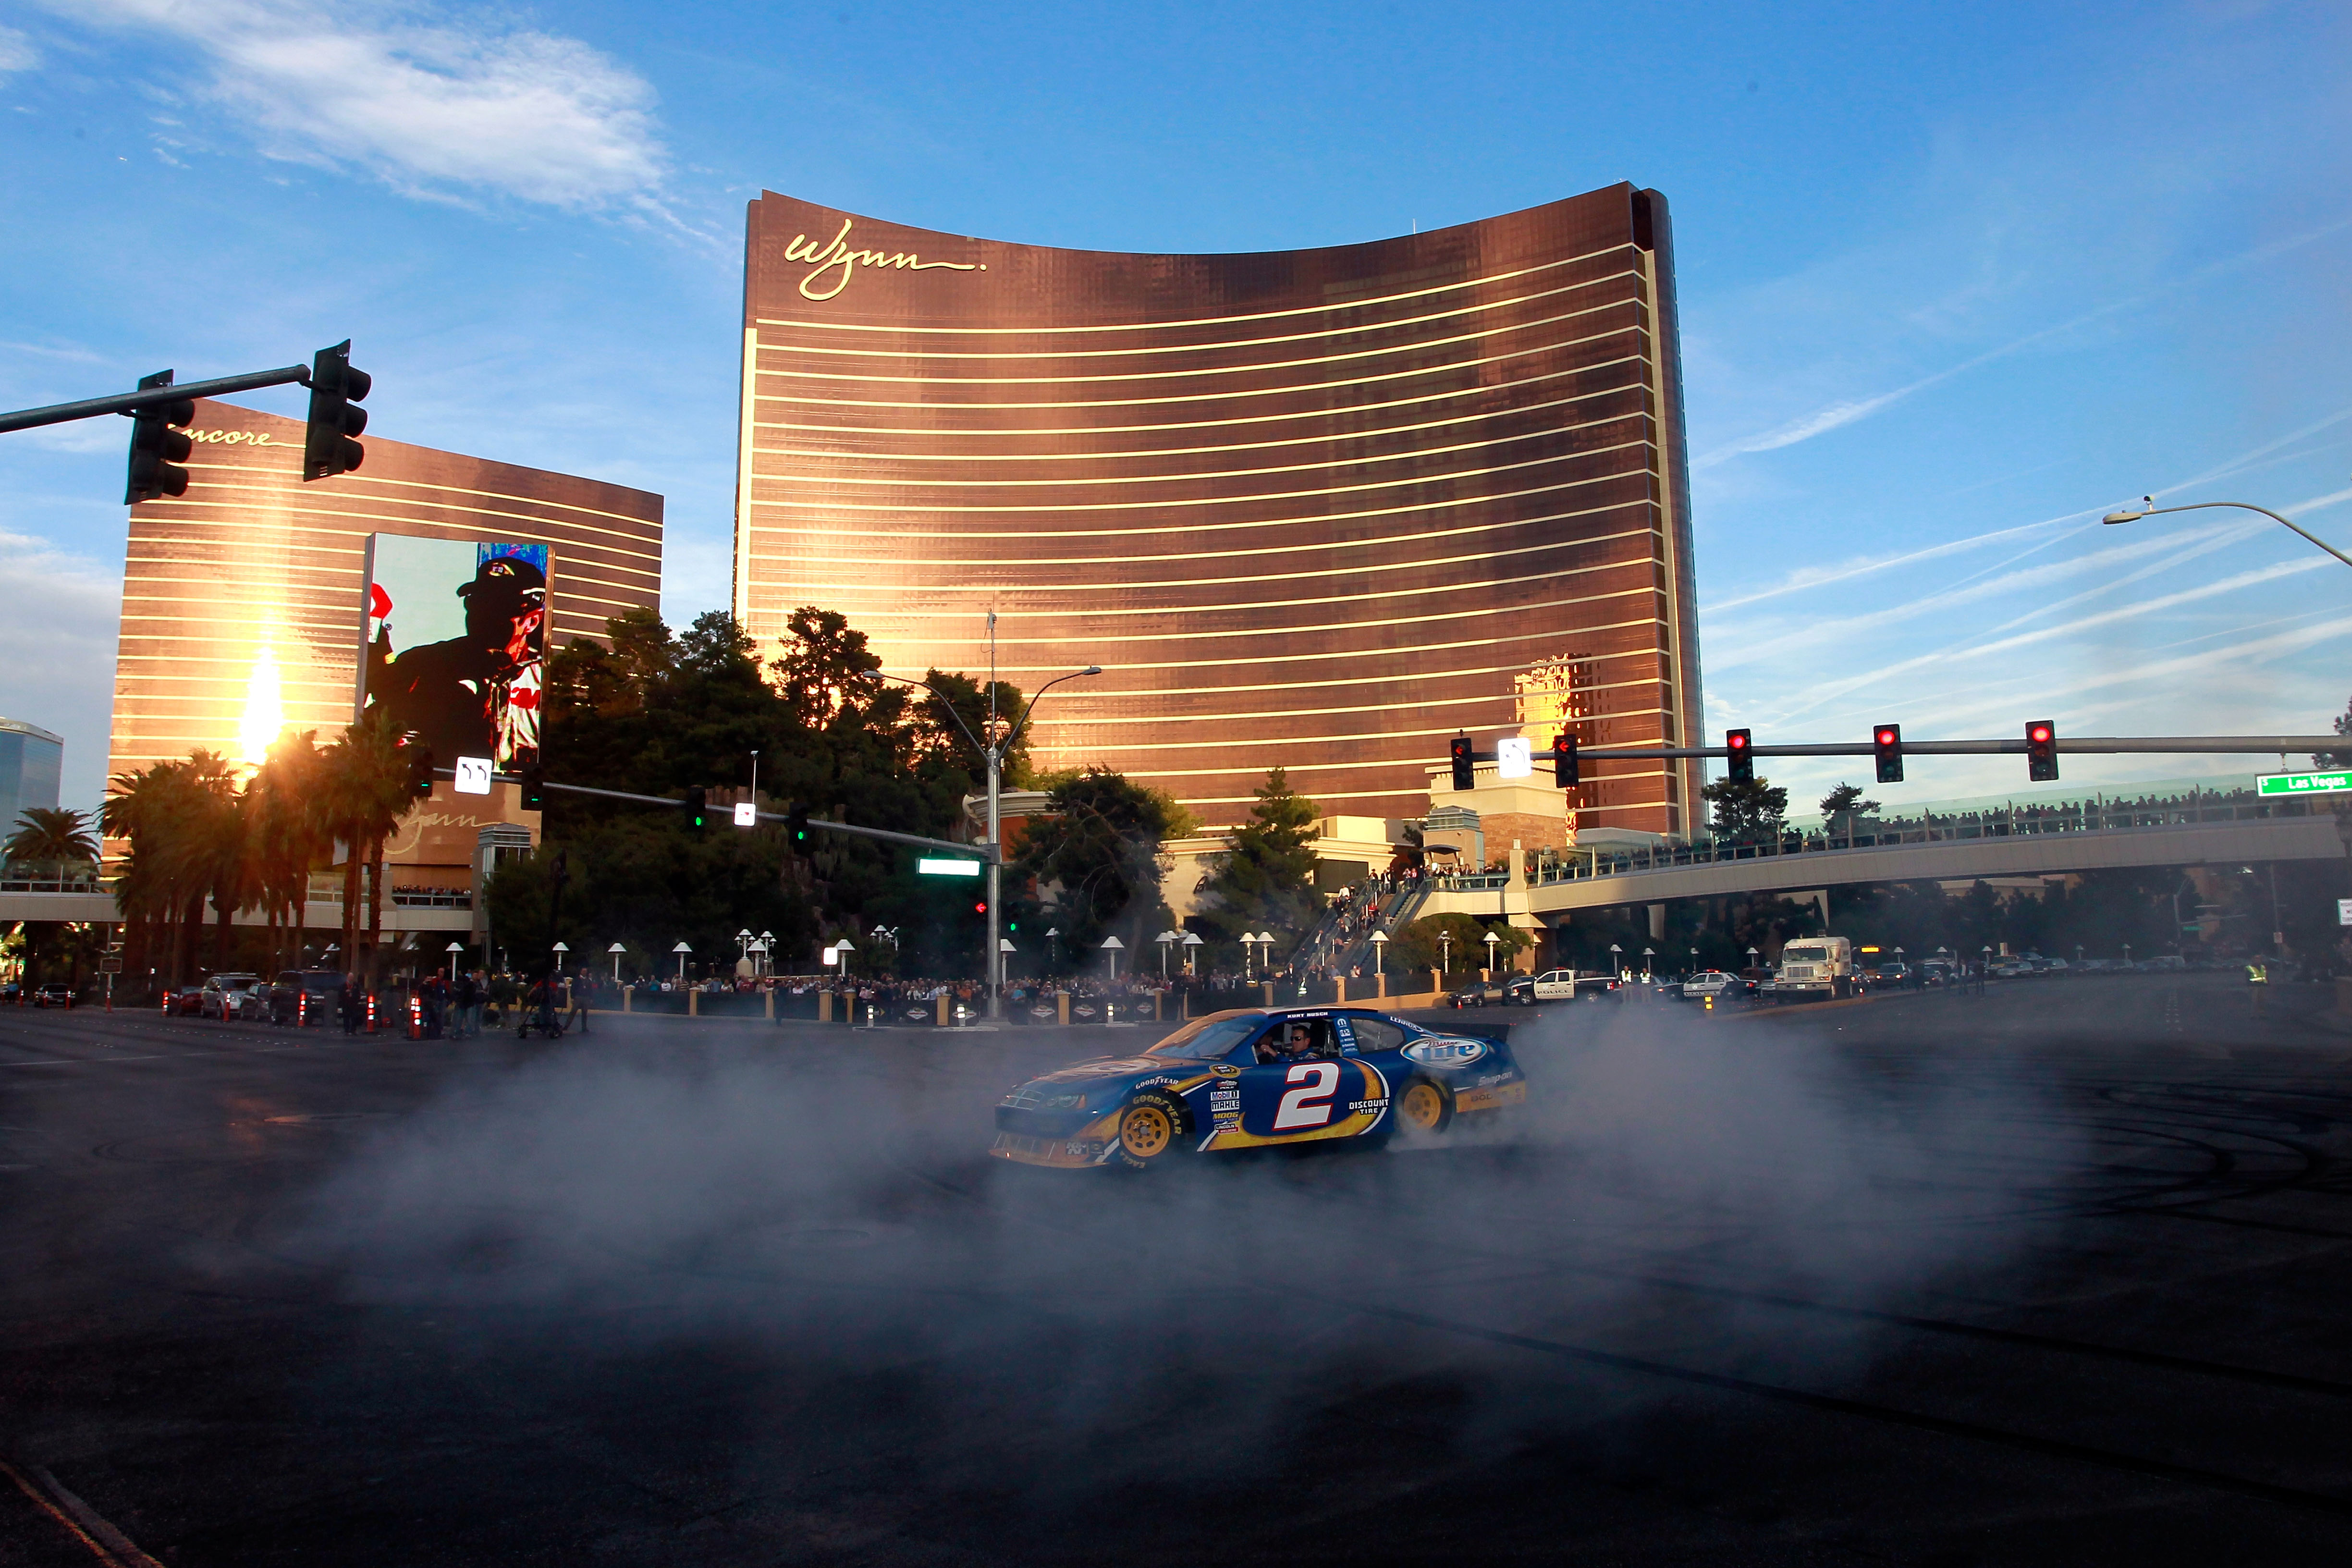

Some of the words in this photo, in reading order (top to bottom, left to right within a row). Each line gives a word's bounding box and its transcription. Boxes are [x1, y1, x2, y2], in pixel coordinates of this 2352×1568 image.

[167, 423, 306, 449] ncore
[2262, 778, 2268, 786] S
[2288, 777, 2309, 789] Las
[2310, 776, 2347, 790] Vegas
[1390, 1016, 1418, 1030] LENNOX
[1421, 1044, 1475, 1061] Lite
[1135, 1076, 1179, 1090] GOODYEAR
[1272, 1061, 1341, 1131] 2
[1212, 1100, 1239, 1110] MAHLE
[1349, 1099, 1389, 1109] DISCOUNT
[1133, 1095, 1182, 1135] GOODYEAR
